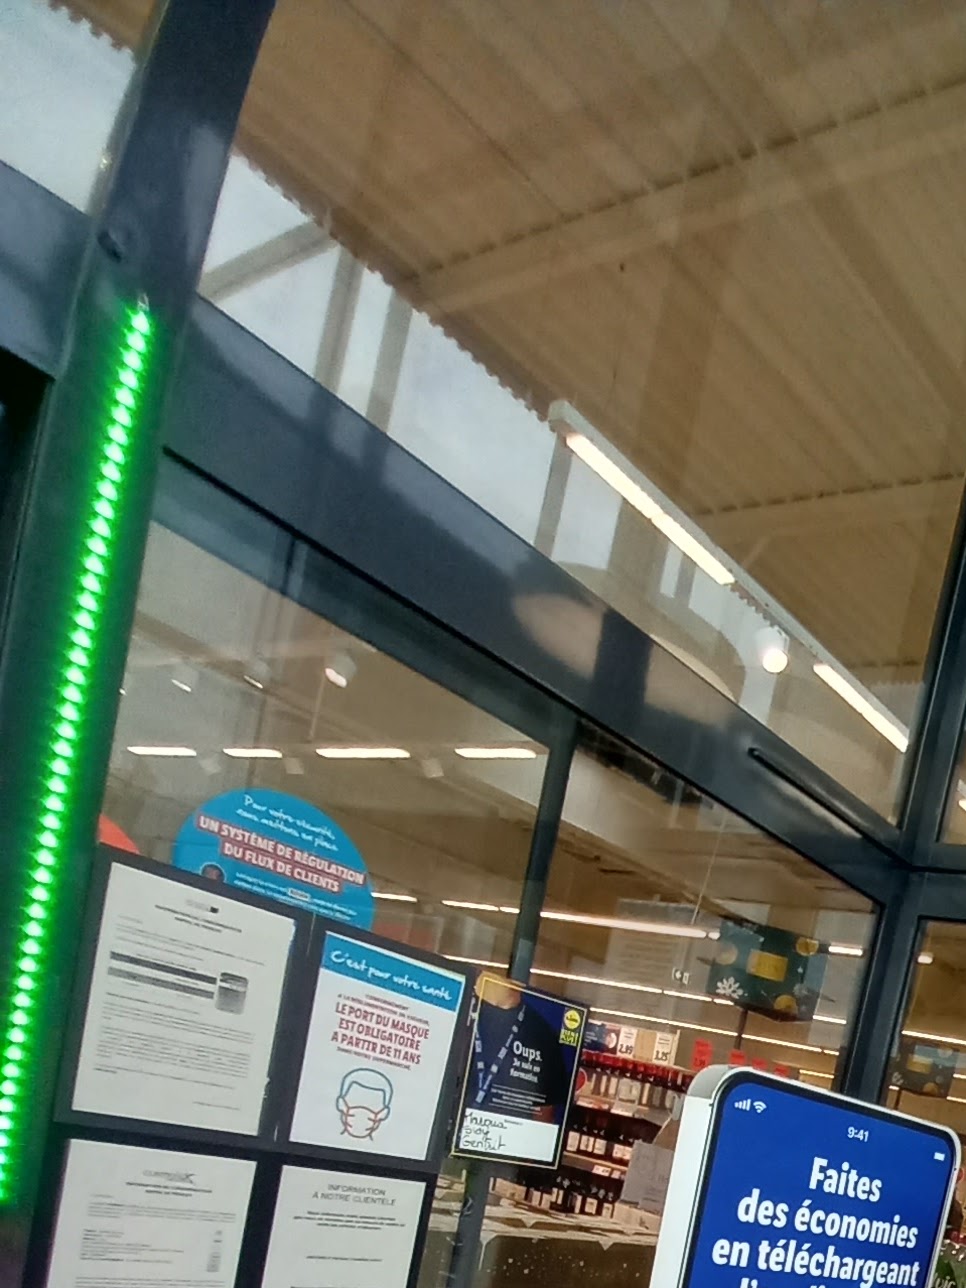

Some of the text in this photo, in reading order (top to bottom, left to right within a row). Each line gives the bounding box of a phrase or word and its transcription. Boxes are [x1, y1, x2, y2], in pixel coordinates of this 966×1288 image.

[200, 815, 365, 885] UN SYSTÈME DE RÉGULATION
[224, 843, 339, 892] DU FLUX DE CLIENTS
[330, 950, 368, 970] C'est
[335, 1002, 346, 1014] LE
[348, 1005, 374, 1021] PORT
[376, 1014, 390, 1026] DU
[391, 1017, 430, 1040] MASQUE
[338, 1018, 421, 1051] EST OBLIGATOIRE
[341, 1034, 377, 1052] PARTIR
[380, 1044, 392, 1056] DE
[402, 1051, 421, 1065] ANS
[513, 1040, 543, 1062] Oups.
[847, 1126, 869, 1142] 9:41
[328, 1184, 386, 1196] INFORMATION
[808, 1156, 882, 1203] Faites
[320, 1192, 350, 1202] NOTRE
[737, 1187, 919, 1249] des économies
[711, 1238, 750, 1268] en
